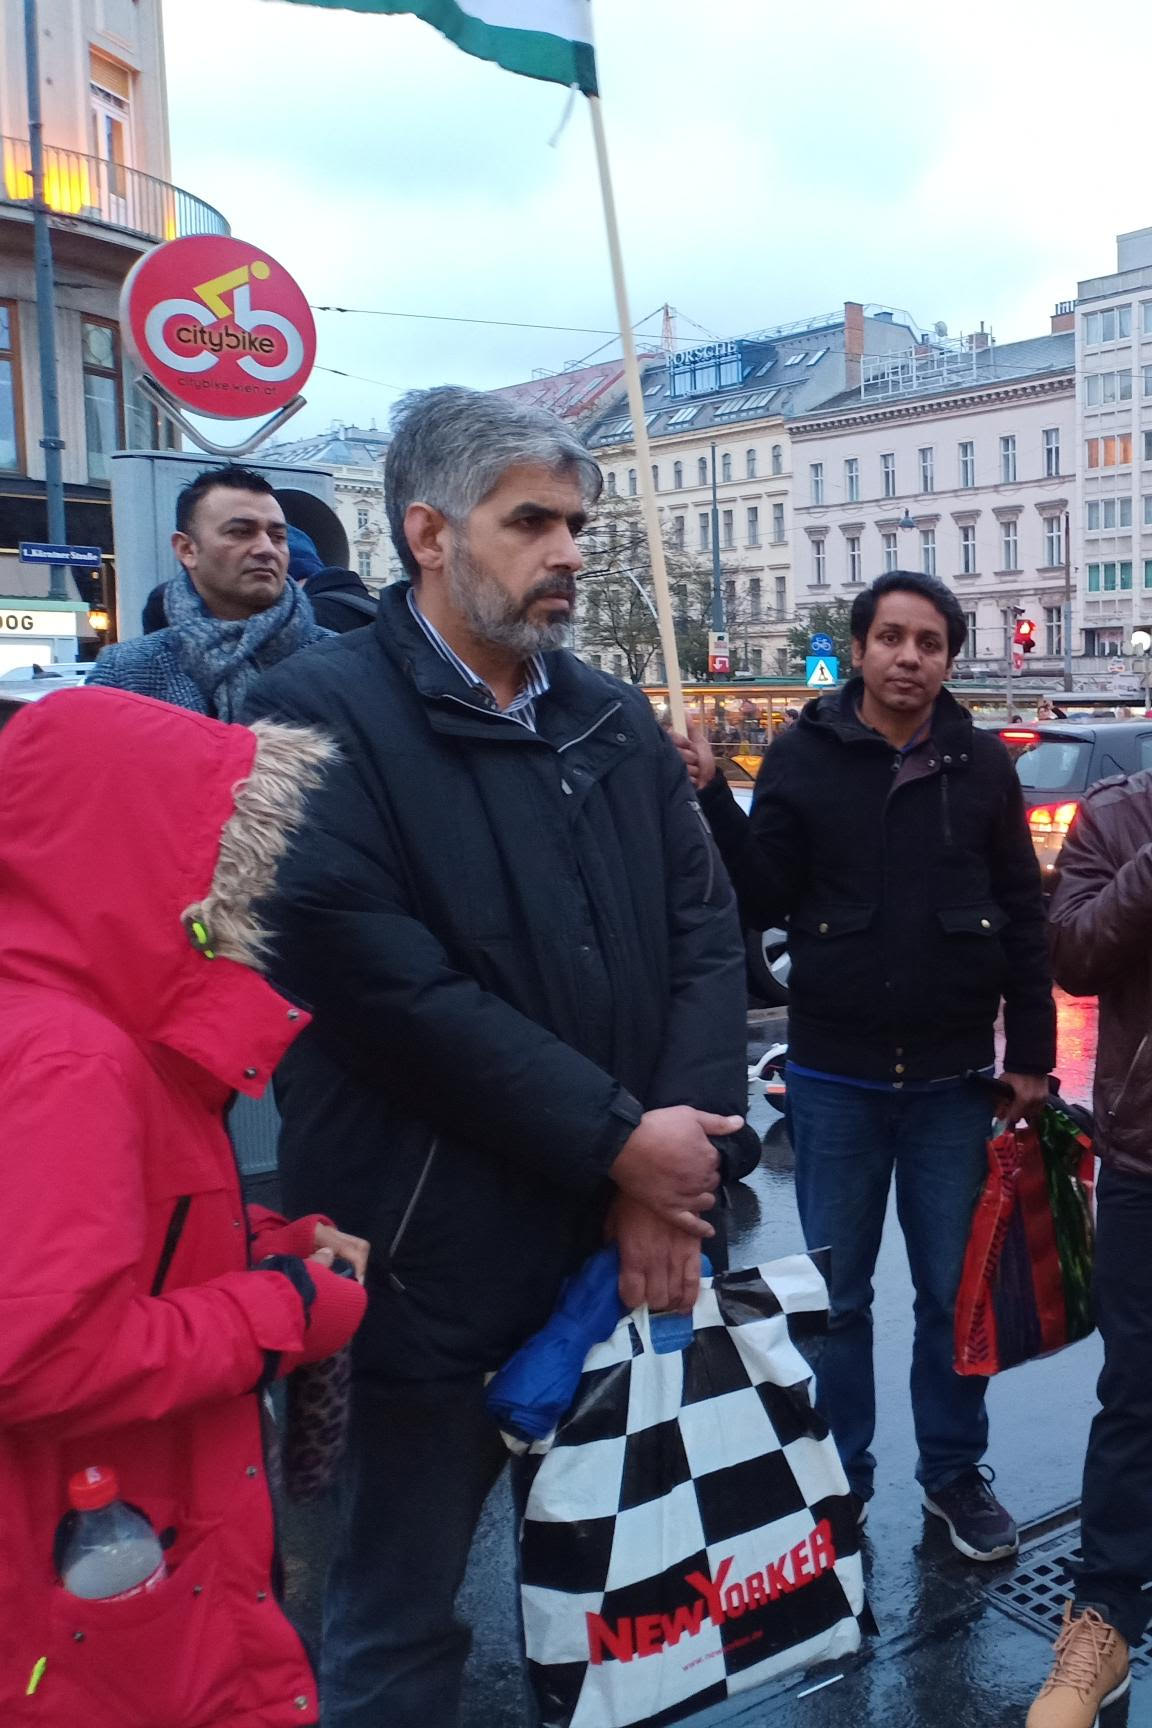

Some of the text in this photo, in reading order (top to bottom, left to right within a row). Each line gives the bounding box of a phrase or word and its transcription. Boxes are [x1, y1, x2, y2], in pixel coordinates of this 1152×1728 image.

[175, 324, 275, 353] citybike
[666, 340, 737, 368] PORSCHE
[0, 614, 34, 631] OG
